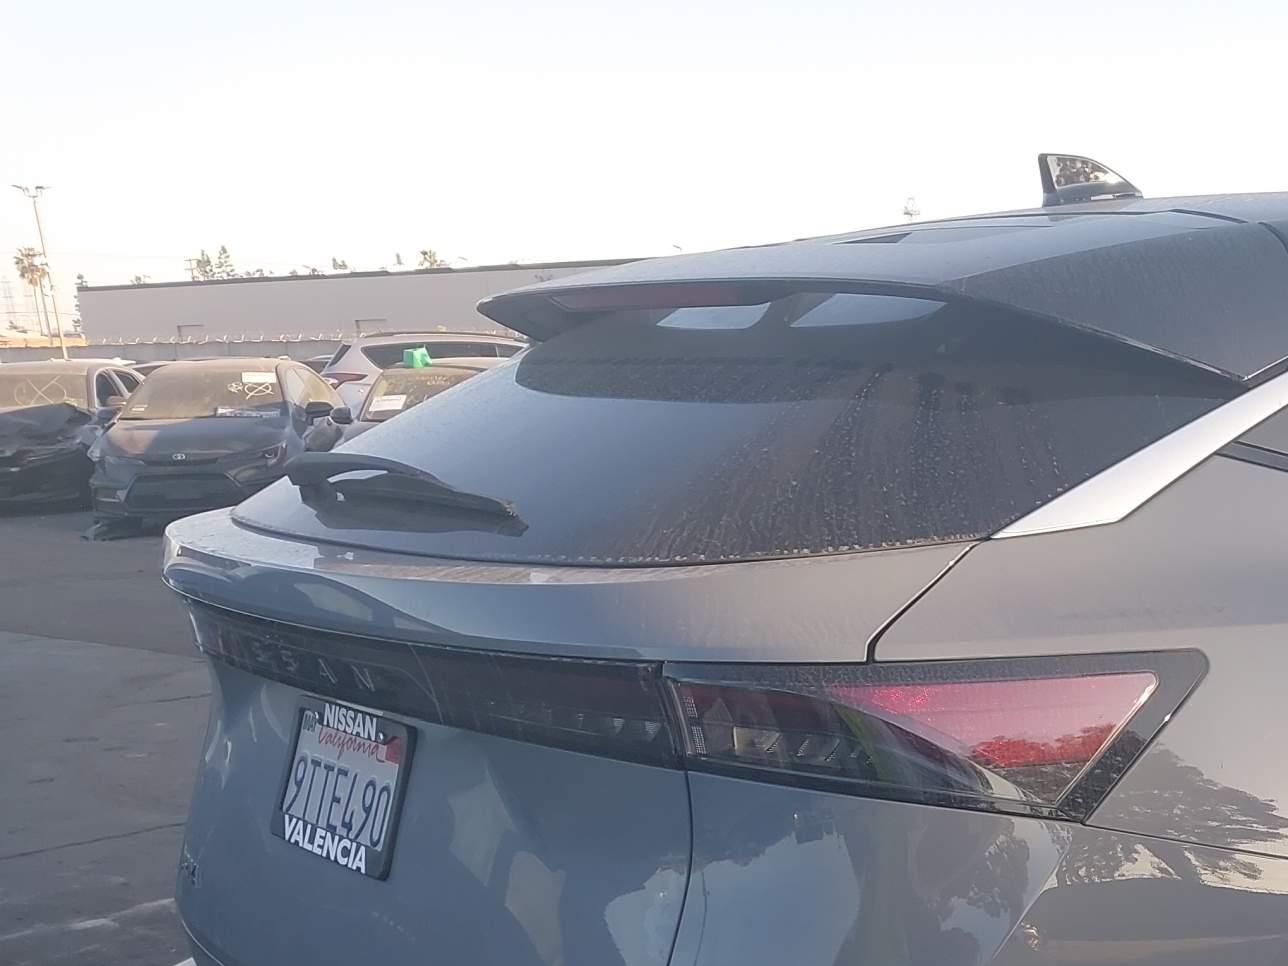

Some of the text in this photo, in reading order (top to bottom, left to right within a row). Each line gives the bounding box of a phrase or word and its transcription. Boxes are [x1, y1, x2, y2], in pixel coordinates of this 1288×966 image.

[323, 703, 377, 741] NISSAN
[285, 755, 391, 848] 9TTE490
[284, 814, 366, 874] VALENCIA
